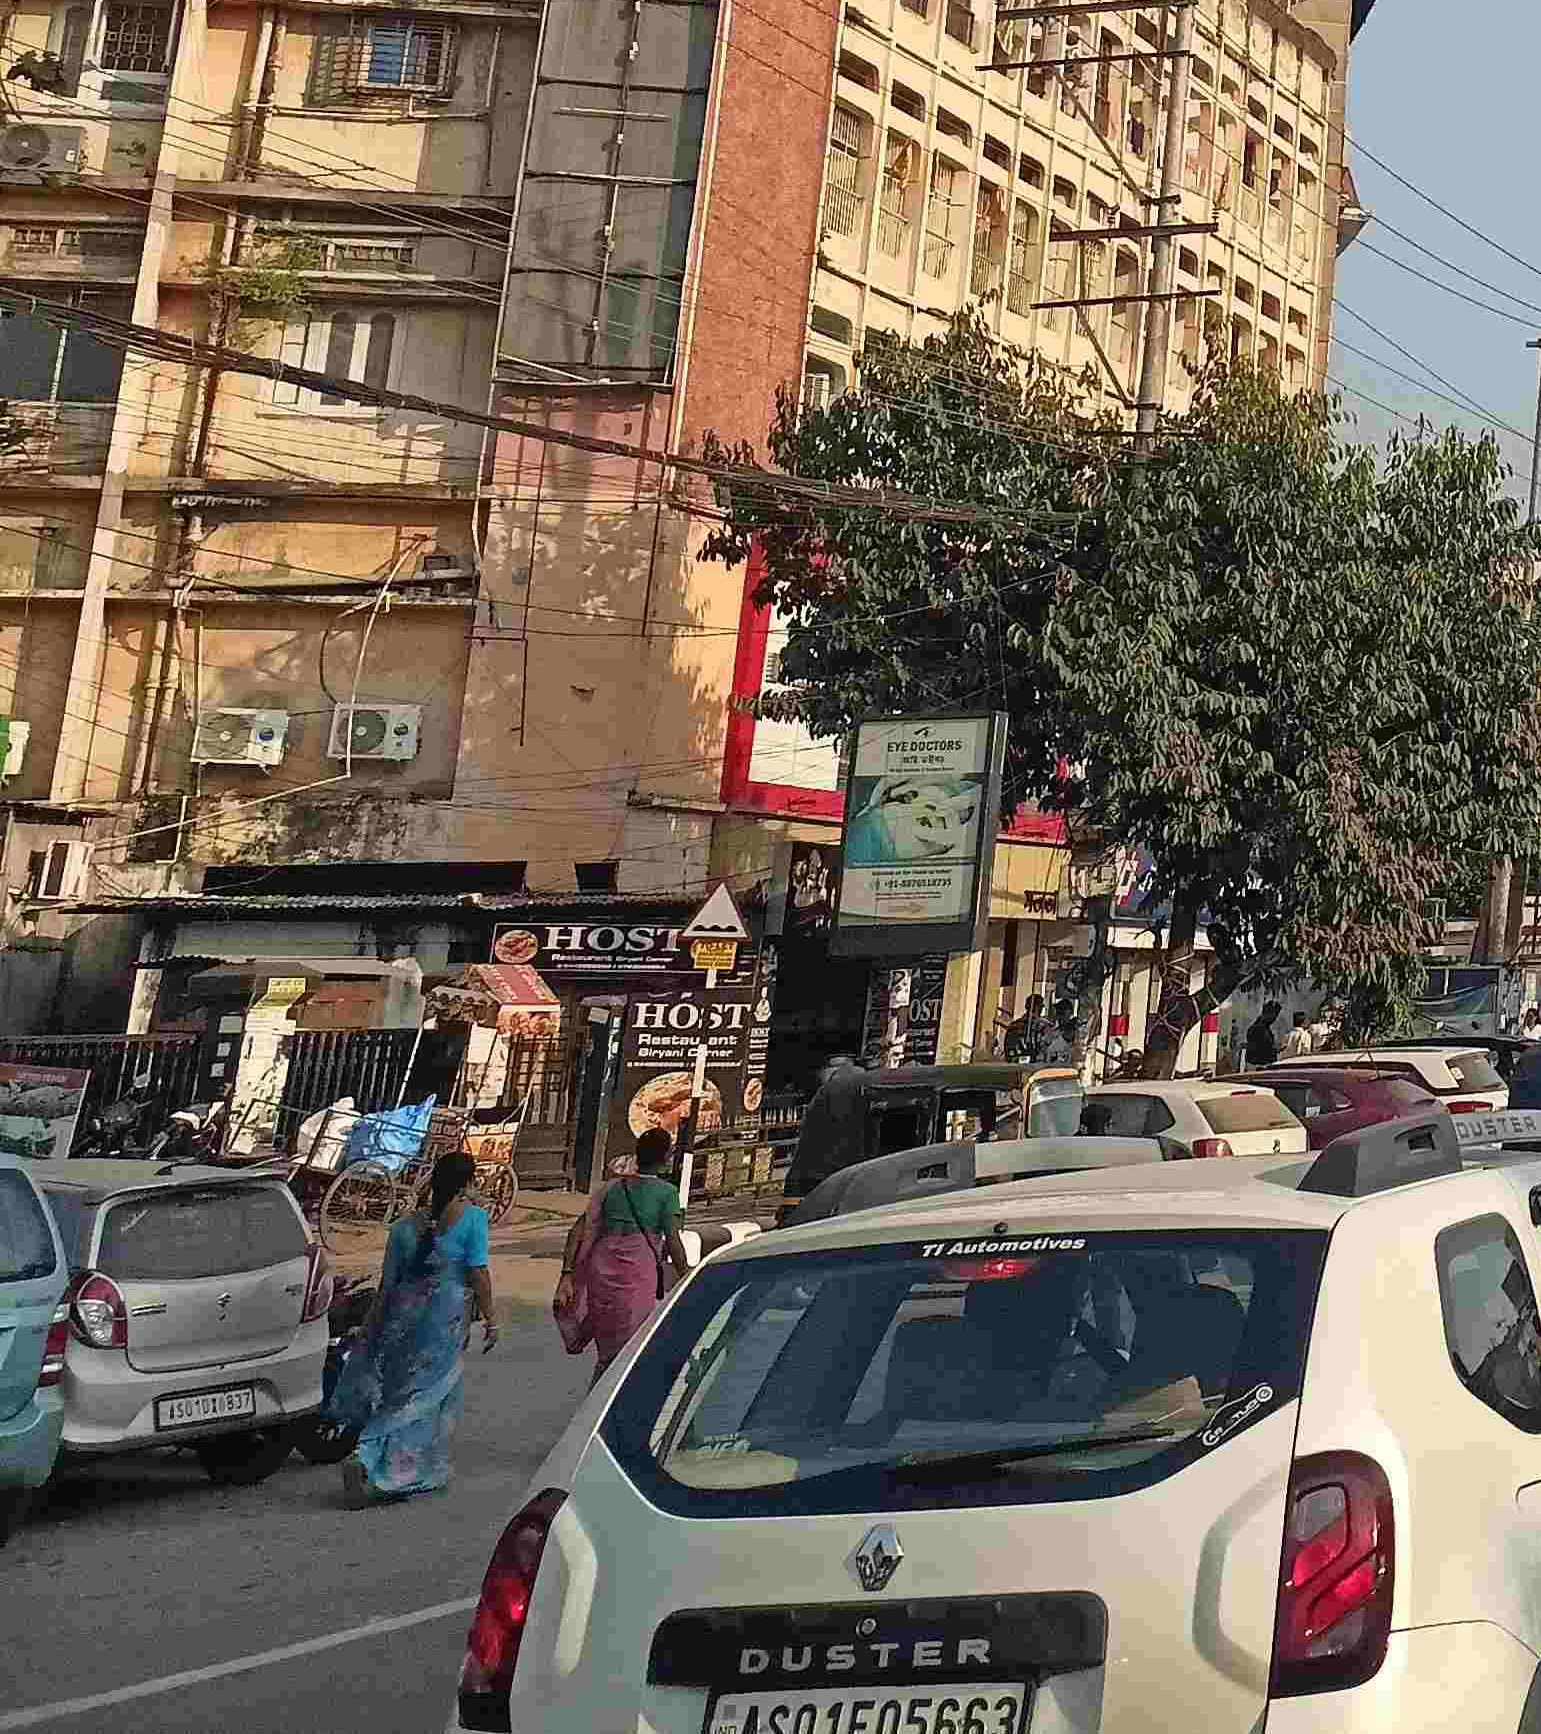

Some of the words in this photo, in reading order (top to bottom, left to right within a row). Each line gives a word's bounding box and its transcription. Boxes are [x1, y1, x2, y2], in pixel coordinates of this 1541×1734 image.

[887, 741, 909, 753] EYE
[909, 739, 963, 752] DOCTORS
[541, 925, 686, 952] HOST
[912, 998, 945, 1022] OST
[637, 1034, 739, 1046] Restauant
[947, 1237, 1086, 1256] Automotives
[738, 1637, 992, 1674] DUSTER
